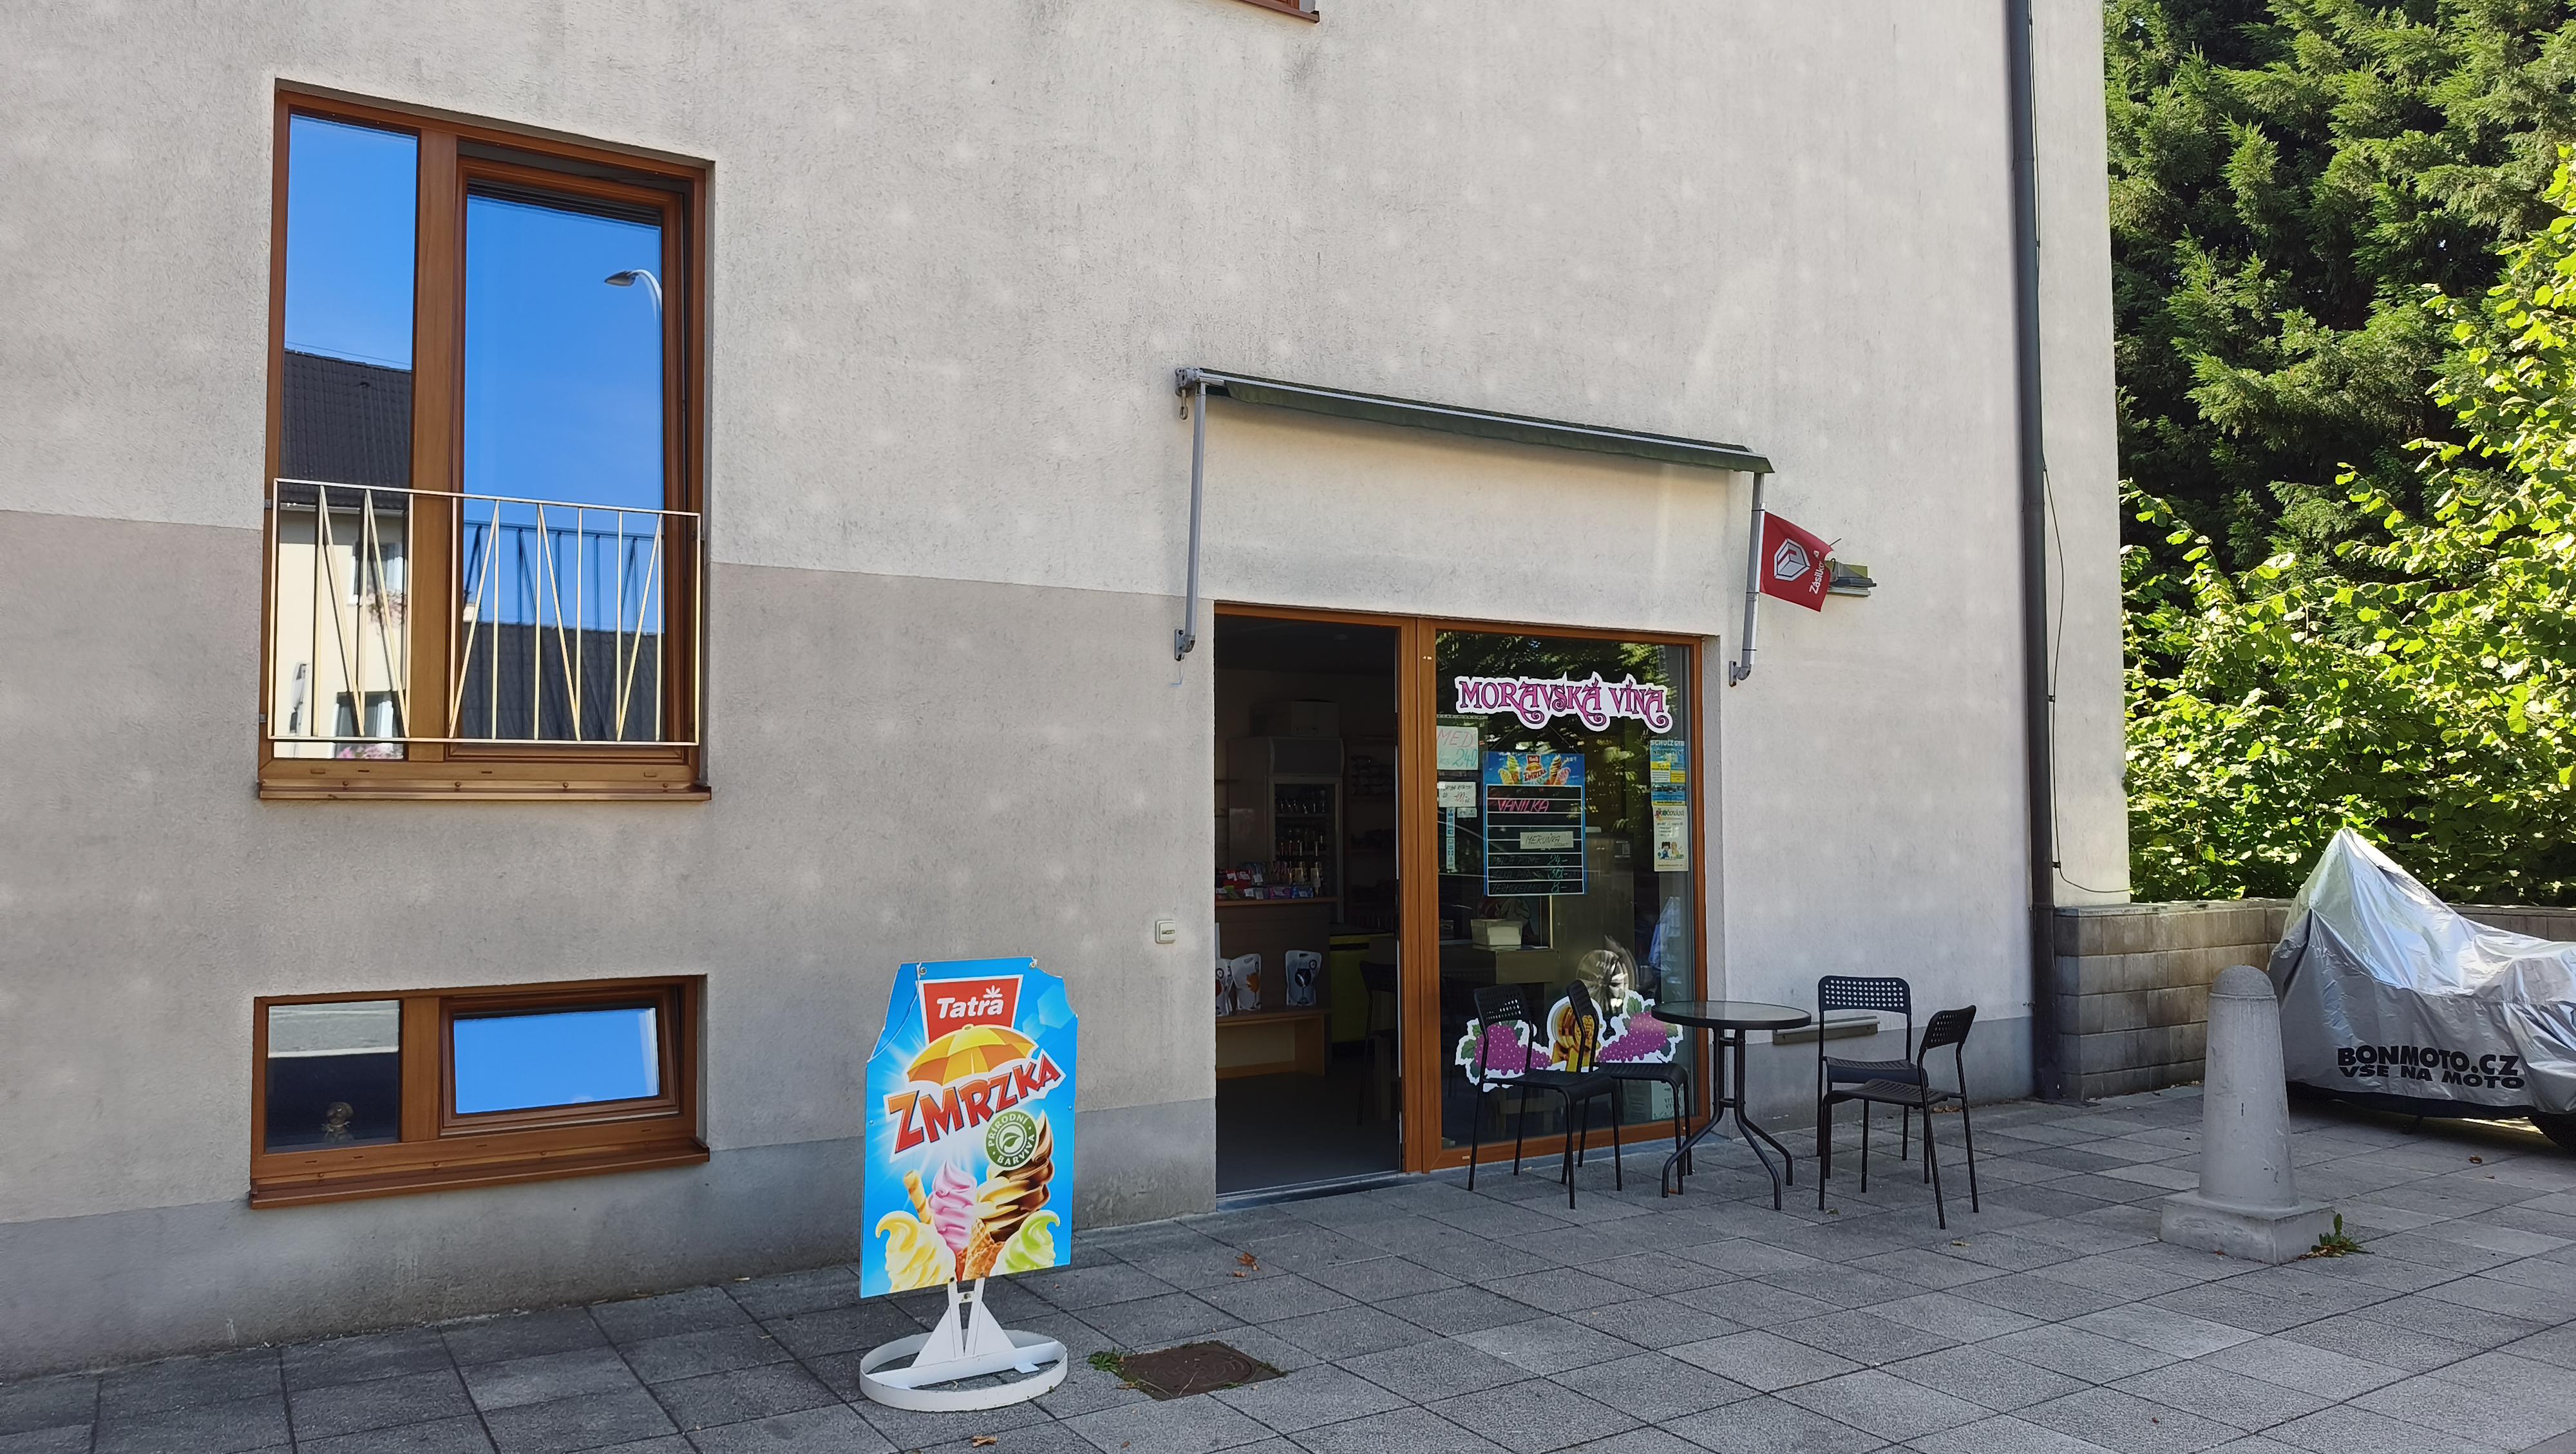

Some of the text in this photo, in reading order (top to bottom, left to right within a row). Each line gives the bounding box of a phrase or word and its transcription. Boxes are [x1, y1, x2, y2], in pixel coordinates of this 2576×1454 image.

[1459, 677, 1669, 728] MORAVSKÁ VÍNA
[1452, 748, 1477, 768] 240
[1498, 799, 1549, 813] VANILKA
[937, 996, 1004, 1019] Tatra
[2338, 1044, 2519, 1076] BONMOTO.CZ
[2401, 1066, 2433, 1082] NA
[2441, 1071, 2525, 1089] MOTO
[888, 1053, 1061, 1154] ZMRZKA
[988, 1113, 1030, 1147] PŘÍRODNÍ
[997, 1133, 1036, 1166] BARVIVA
